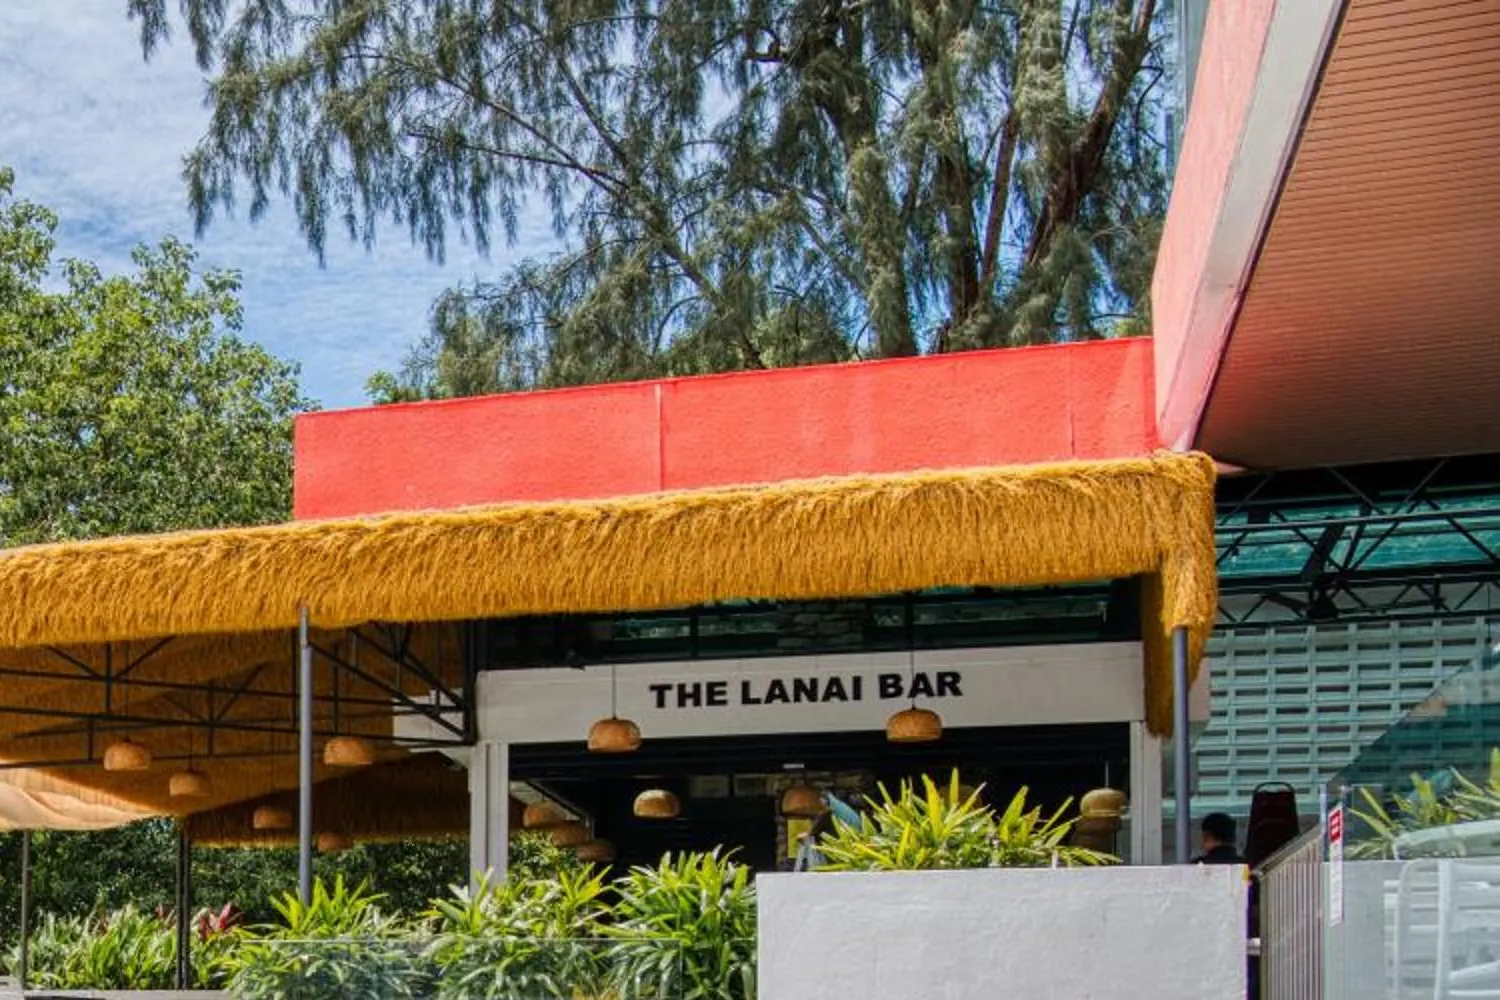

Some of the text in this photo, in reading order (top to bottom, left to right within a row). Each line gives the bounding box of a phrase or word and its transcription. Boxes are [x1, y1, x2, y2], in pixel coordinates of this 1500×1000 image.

[649, 671, 964, 709] THE LANAI BAR
